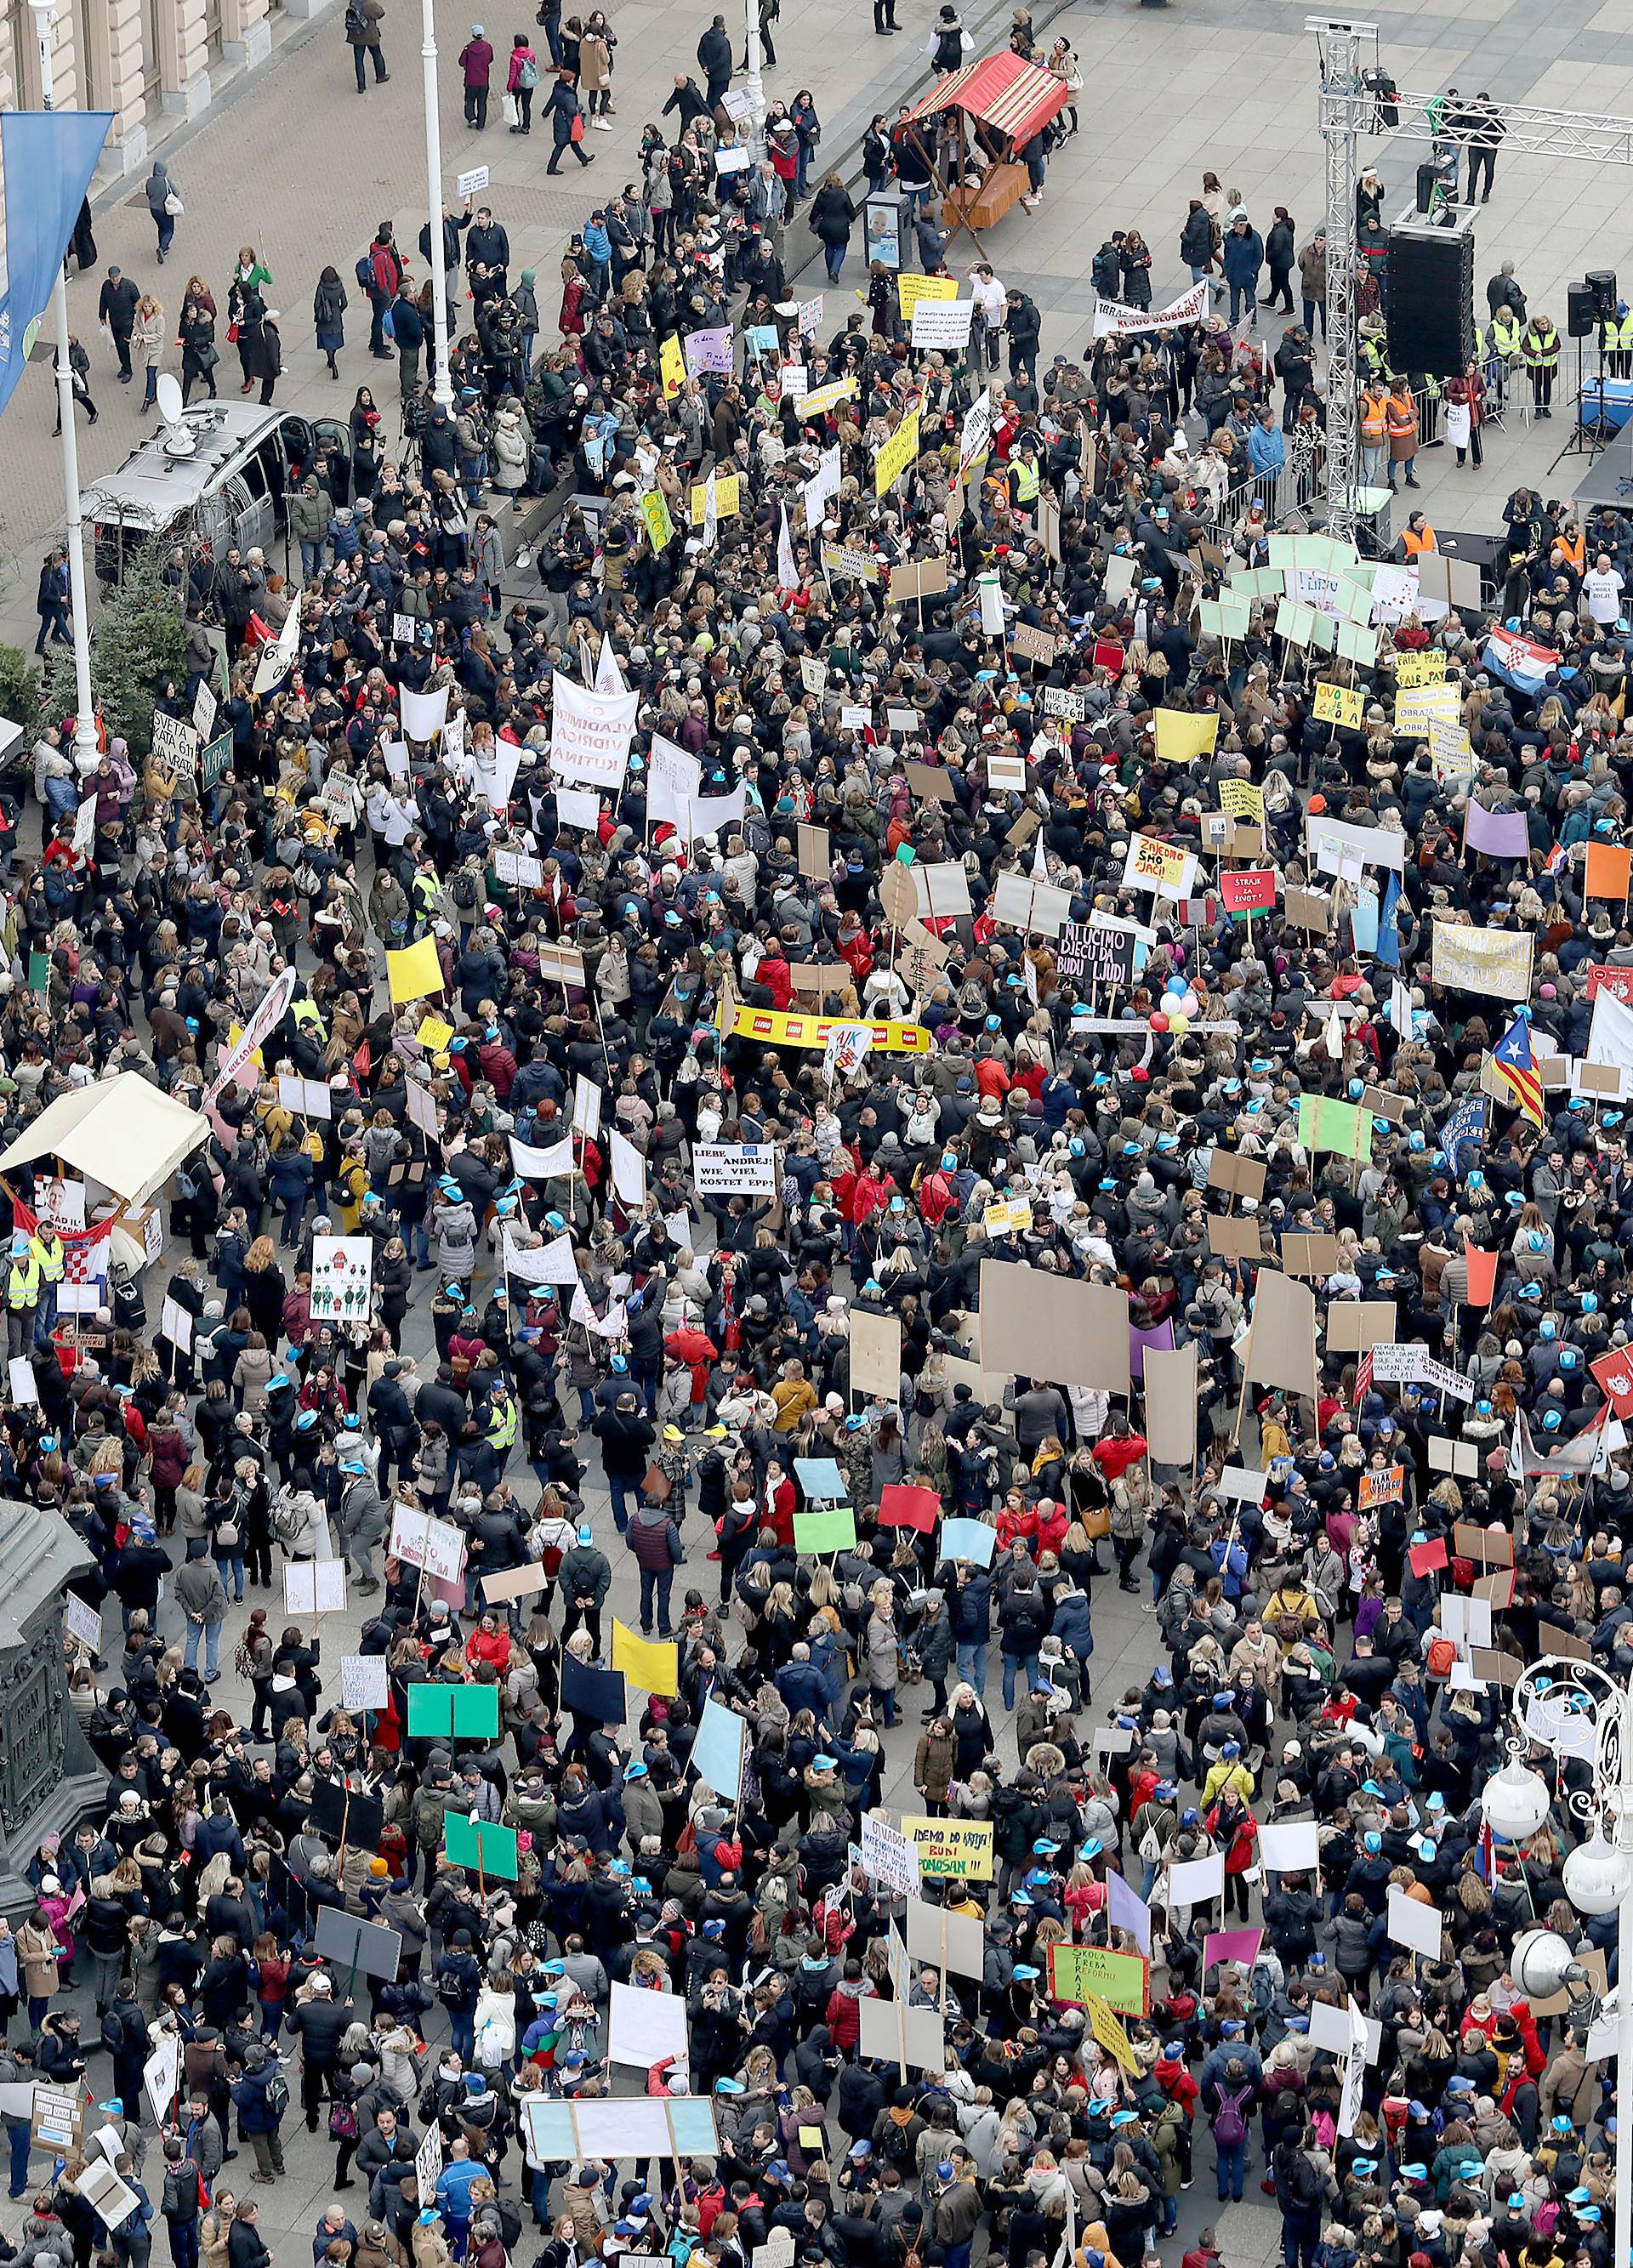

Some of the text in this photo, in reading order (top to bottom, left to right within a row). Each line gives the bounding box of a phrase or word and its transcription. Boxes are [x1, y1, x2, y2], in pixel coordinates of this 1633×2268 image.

[1397, 652, 1445, 665] FAIR PLAY
[1429, 670, 1444, 682] PAY
[1318, 685, 1363, 708] OVO VAM
[1332, 700, 1342, 709] JE
[1317, 702, 1358, 725] ŠKOLA
[154, 711, 187, 742] SVETA
[1403, 723, 1428, 732] OBRA
[168, 751, 195, 776] VRATA
[1140, 838, 1184, 861] ZAJEDNO
[1139, 850, 1163, 865] SMO
[1065, 924, 1125, 951] MI UČIMO
[1061, 939, 1114, 963] DJECU DA
[1056, 956, 1126, 984] BUDU LJUDI
[754, 1020, 772, 1031] LEGO
[787, 1024, 802, 1034] LEGO
[902, 1033, 917, 1043] LEGO
[723, 1157, 772, 1166] ANDREJ!
[49, 1214, 68, 1225] SAD
[54, 1225, 83, 1234] IKADA!
[1419, 1356, 1448, 1375] JEDINA
[1421, 1365, 1441, 1380] SMO
[1371, 1471, 1391, 1486] VLAK
[913, 1828, 944, 1845] IDEMO
[949, 1832, 960, 1844] DO
[929, 1845, 958, 1856] BUDI
[1073, 1947, 1106, 1961] ŠKOLA
[1073, 1957, 1107, 1970] TREBA
[54, 2108, 70, 2118] VAM
